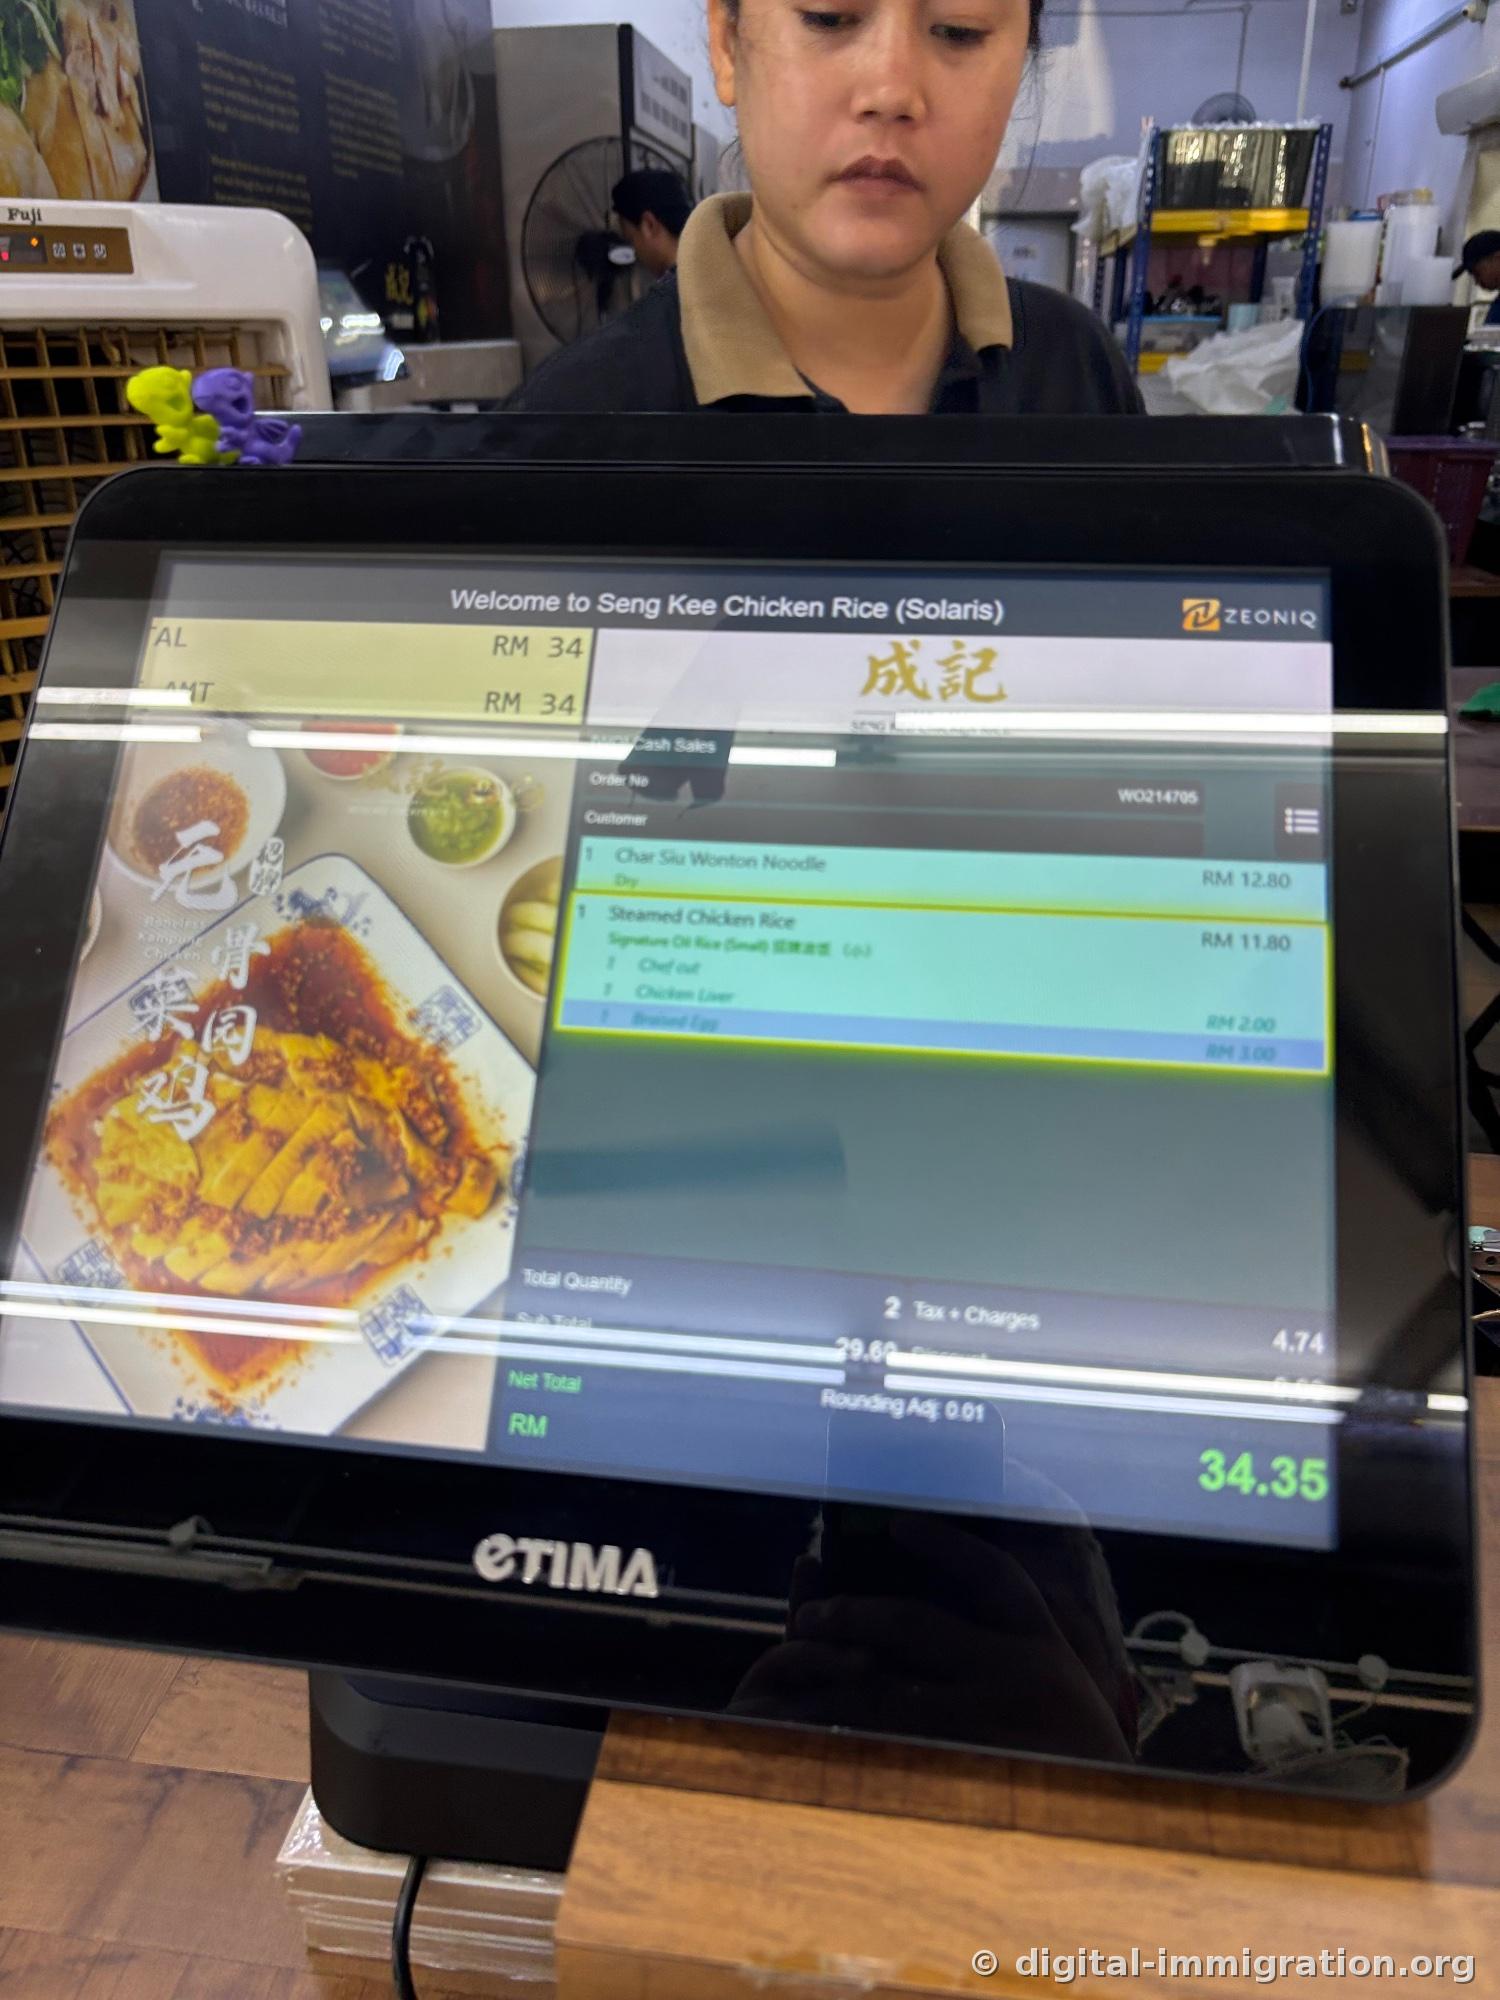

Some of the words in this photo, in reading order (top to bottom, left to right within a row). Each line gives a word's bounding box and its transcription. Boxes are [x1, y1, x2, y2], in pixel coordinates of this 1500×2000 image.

[7, 206, 42, 226] Fuji
[450, 588, 561, 614] Welcome
[566, 592, 590, 613] to
[597, 592, 661, 619] Seng
[667, 594, 717, 616] Kee
[723, 594, 824, 618] Chicken
[831, 597, 888, 619] Rice
[896, 598, 1004, 625] (Solaris)
[1224, 607, 1318, 630] ZEONIQ
[150, 626, 188, 648] AL
[492, 635, 529, 657] RM
[548, 636, 584, 659] 34
[860, 639, 1008, 703] 成記
[485, 691, 521, 714] RM
[540, 692, 577, 716] 34
[674, 736, 717, 754] Sales
[589, 771, 626, 787] Order
[628, 775, 649, 788] No
[584, 809, 648, 827] Customer
[614, 846, 655, 865] Char
[659, 849, 685, 866] Siu
[689, 850, 758, 868] Wonton
[763, 854, 827, 873] Noodle
[1202, 869, 1233, 886] RM
[1240, 871, 1291, 889] 12.80
[609, 904, 683, 924] Steamed
[687, 908, 754, 927] Chicken
[759, 911, 796, 929] Rice
[1201, 931, 1233, 949] RM
[1240, 933, 1291, 951] 11.80
[637, 957, 674, 974] Chef
[635, 983, 694, 999] Chicken
[523, 1268, 561, 1288] Total
[564, 1272, 632, 1298] Quantity
[884, 1296, 901, 1319] 2
[914, 1300, 945, 1321] Tax
[964, 1305, 1041, 1332] Charges
[1272, 1329, 1325, 1355] 4.74
[508, 1370, 539, 1390] Net
[543, 1372, 581, 1393] Total
[821, 1389, 905, 1419] Rounding
[945, 1400, 984, 1423] 0.01
[508, 1412, 548, 1438] RM
[1199, 1448, 1328, 1501] 34.35
